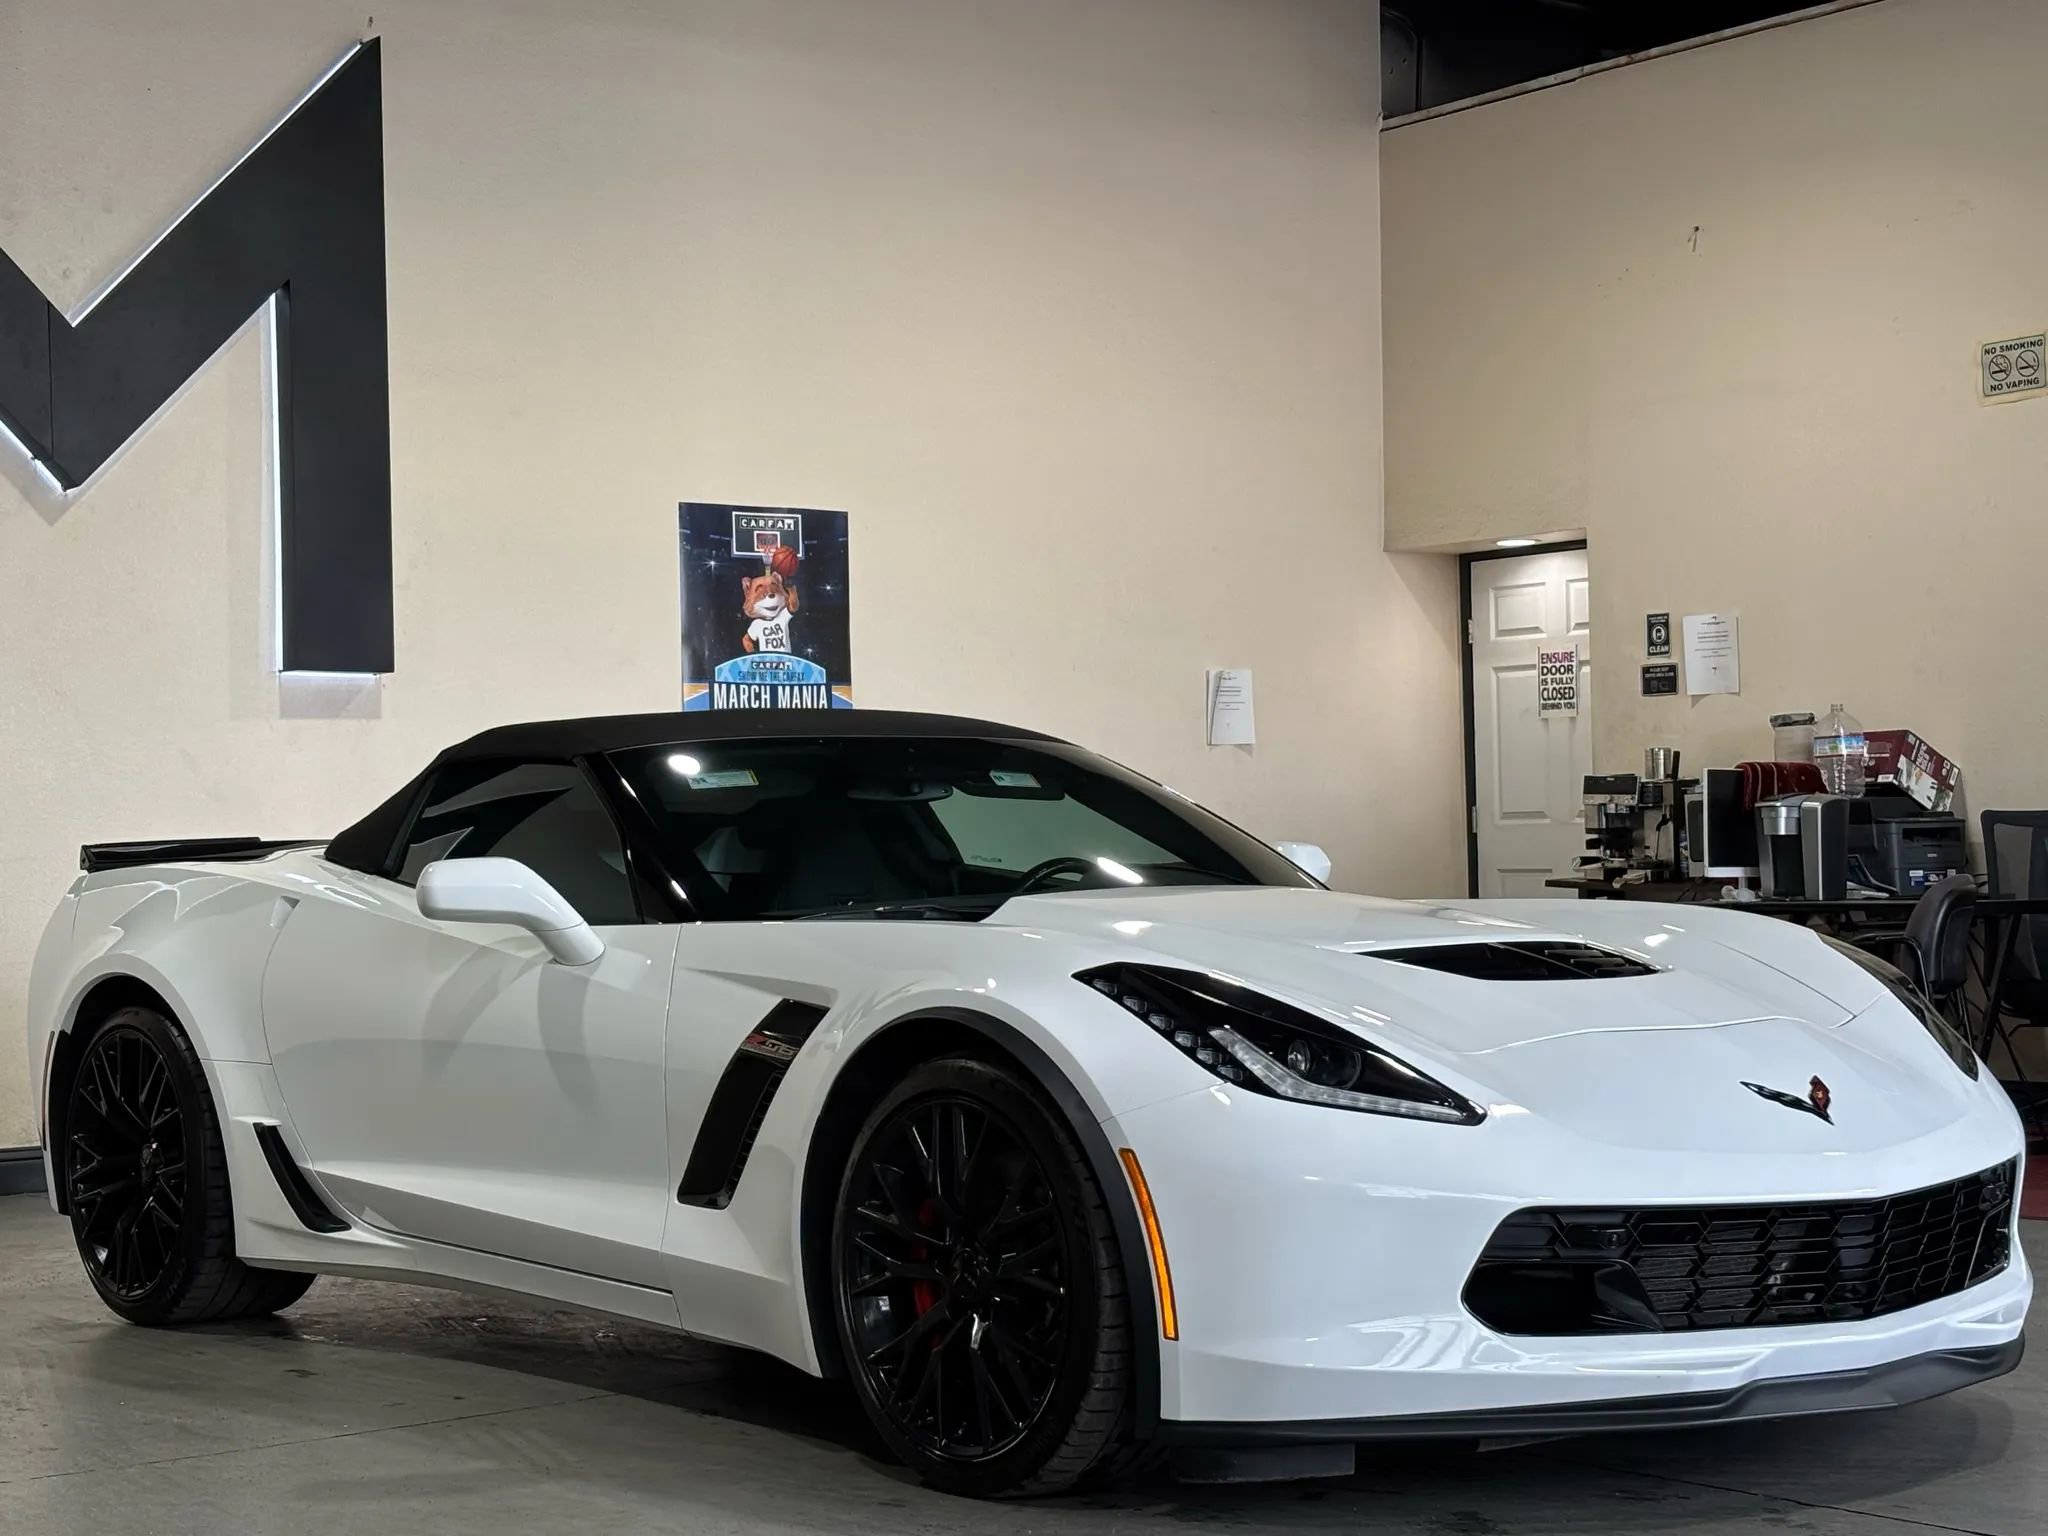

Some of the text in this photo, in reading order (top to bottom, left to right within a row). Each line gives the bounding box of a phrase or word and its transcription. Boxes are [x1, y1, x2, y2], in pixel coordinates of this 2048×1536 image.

[1984, 339, 2043, 355] NO SMOKING
[1990, 377, 2040, 392] NO VAPING
[741, 518, 794, 530] CARFAX
[763, 623, 783, 637] CAR
[765, 635, 785, 649] FOX
[1650, 645, 1669, 653] CLEAN
[1541, 651, 1574, 664] ENSURE
[1541, 664, 1574, 676] DOOR
[1541, 676, 1574, 686] IS FULLY
[714, 683, 828, 709] MARCH MANIA
[1541, 687, 1575, 701] CLOSED
[1563, 702, 1575, 710] YOU
